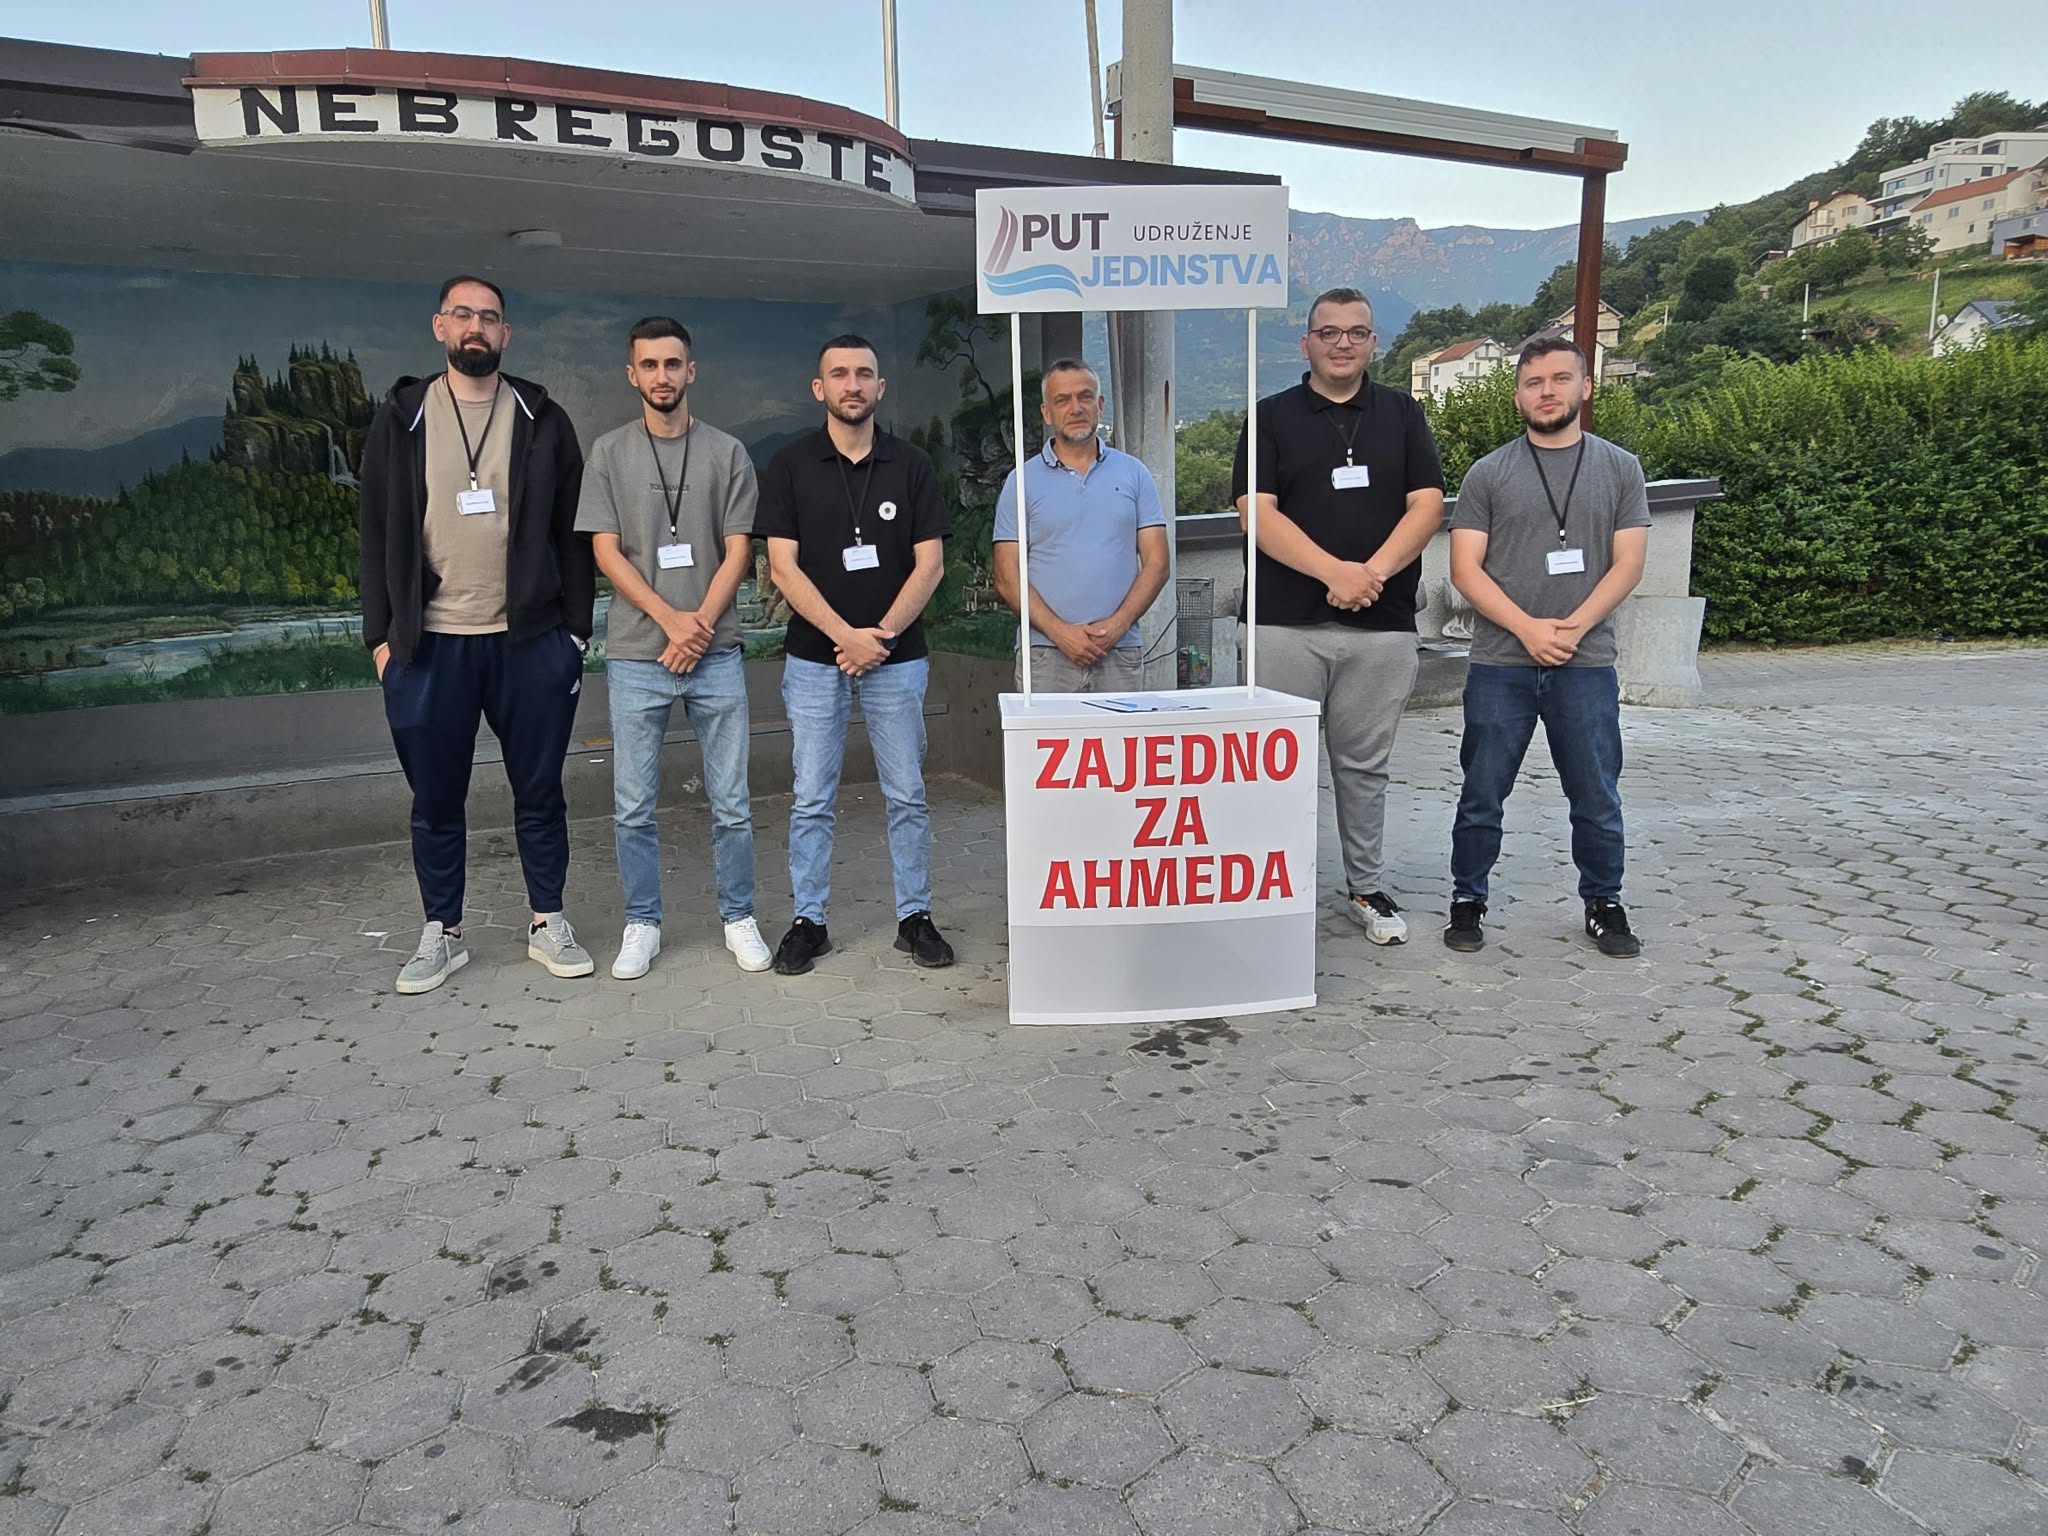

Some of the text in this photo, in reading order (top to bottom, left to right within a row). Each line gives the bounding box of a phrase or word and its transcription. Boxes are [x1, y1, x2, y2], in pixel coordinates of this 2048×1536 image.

[1022, 212, 1110, 252] PUT
[1133, 220, 1252, 242] UDRUŽENJE
[1081, 253, 1283, 288] JEDINSTVA
[1035, 728, 1299, 793] ZAJEDNO
[1133, 796, 1208, 848] ZA
[1039, 850, 1294, 909] AHMEDA
